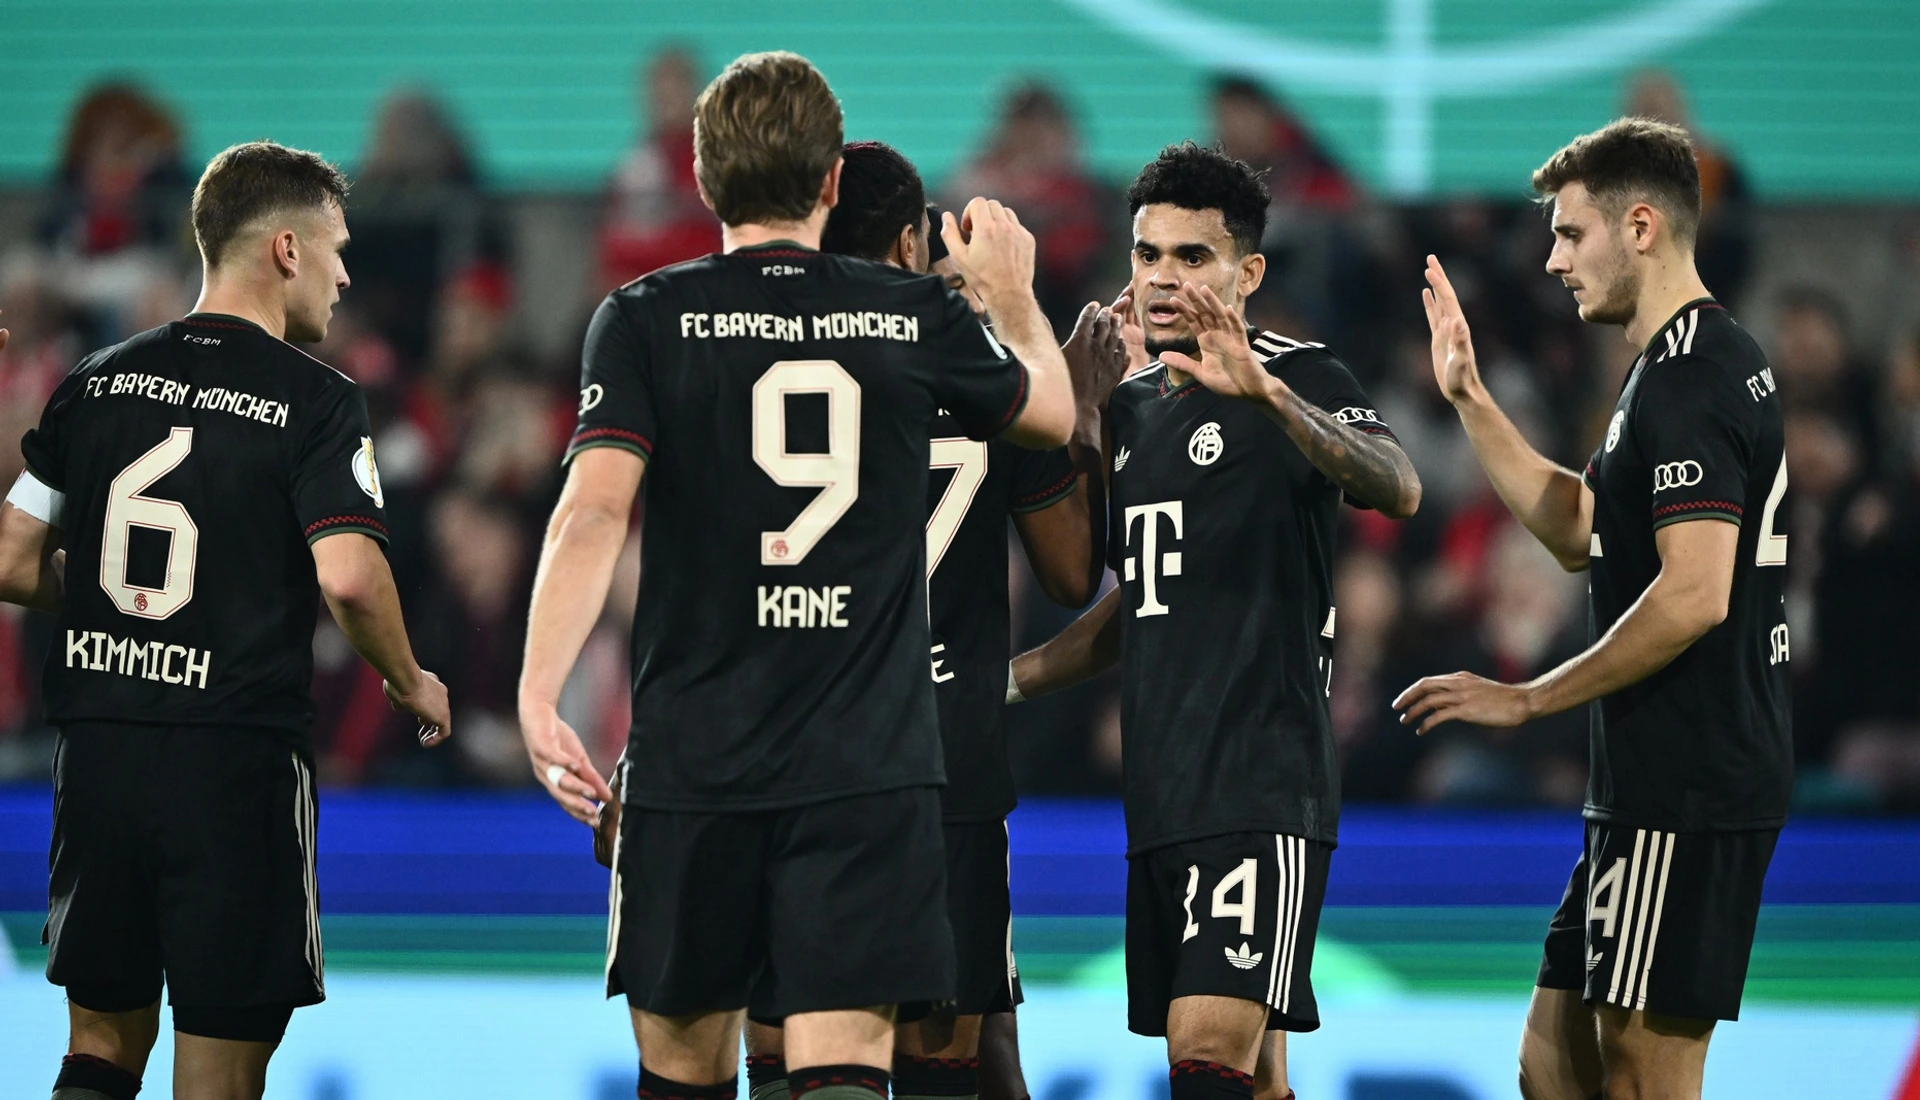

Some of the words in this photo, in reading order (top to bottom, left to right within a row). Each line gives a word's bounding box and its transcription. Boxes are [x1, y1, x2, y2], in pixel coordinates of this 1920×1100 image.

[761, 264, 806, 277] FCBM
[183, 333, 221, 346] FCBM
[680, 313, 710, 338] FC
[713, 312, 804, 342] BAYERN
[812, 311, 919, 342] MÜNCHEN
[84, 376, 108, 398] FC
[109, 373, 190, 405] BAYERN
[192, 387, 290, 428] MÜNCHEN
[1746, 375, 1767, 402] FC
[752, 359, 862, 566] 9
[99, 426, 199, 621] 6
[757, 585, 852, 628] KANE
[66, 629, 211, 690] KIMMICH
